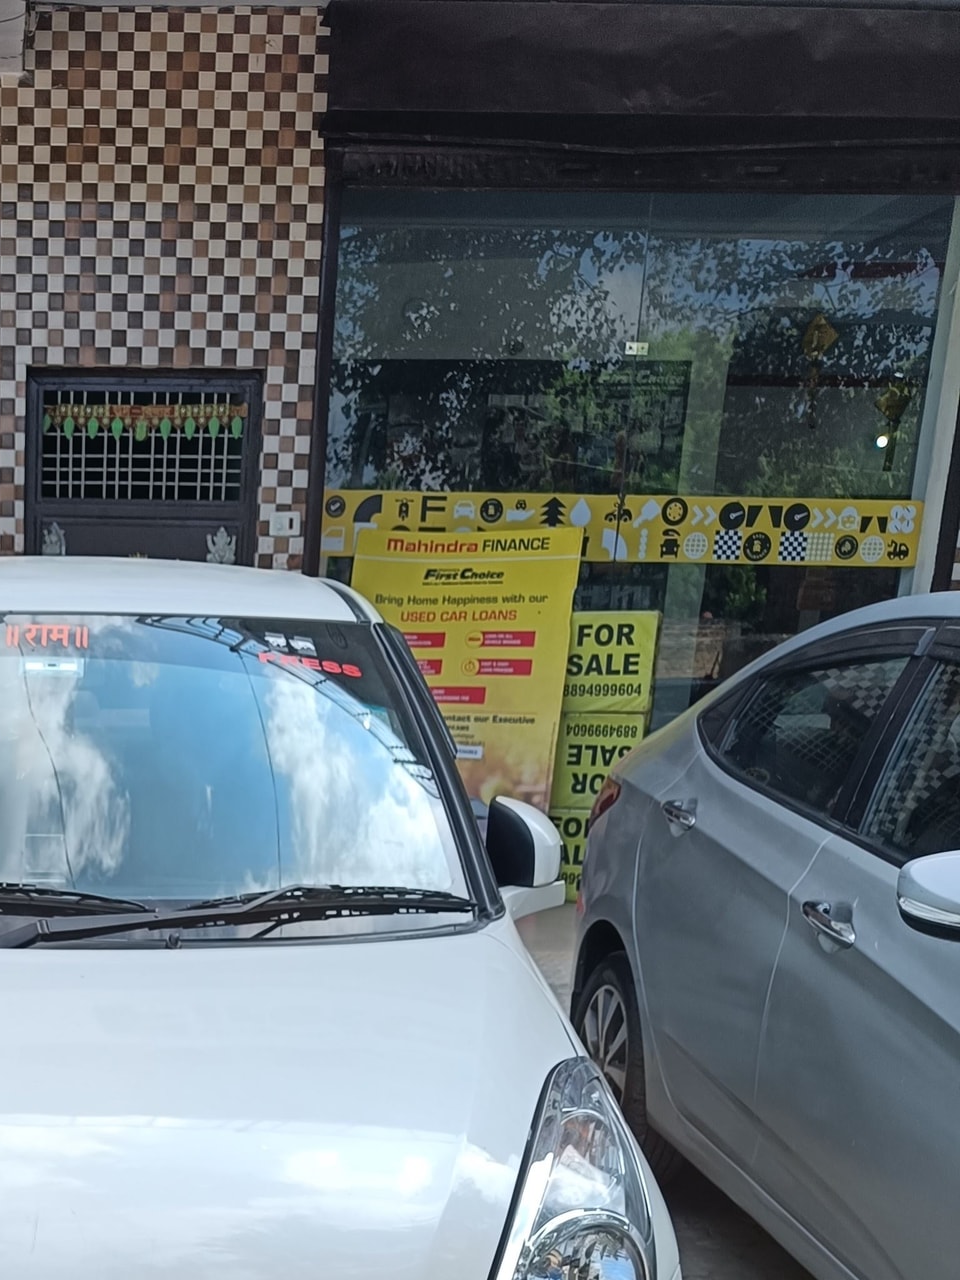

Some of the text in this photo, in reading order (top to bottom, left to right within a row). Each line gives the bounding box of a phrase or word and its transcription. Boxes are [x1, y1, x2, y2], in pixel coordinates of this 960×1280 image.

[386, 536, 551, 554] Mahindra FINANCE
[422, 567, 505, 581] First Choice
[375, 593, 549, 607] Bring Home Happiness with our
[400, 609, 517, 623] USED CAR LOANS
[576, 623, 635, 648] FOR
[566, 652, 641, 677] SALE
[563, 682, 642, 698] 8894999604
[492, 714, 536, 725] Executive
[566, 723, 638, 739] 8894999604
